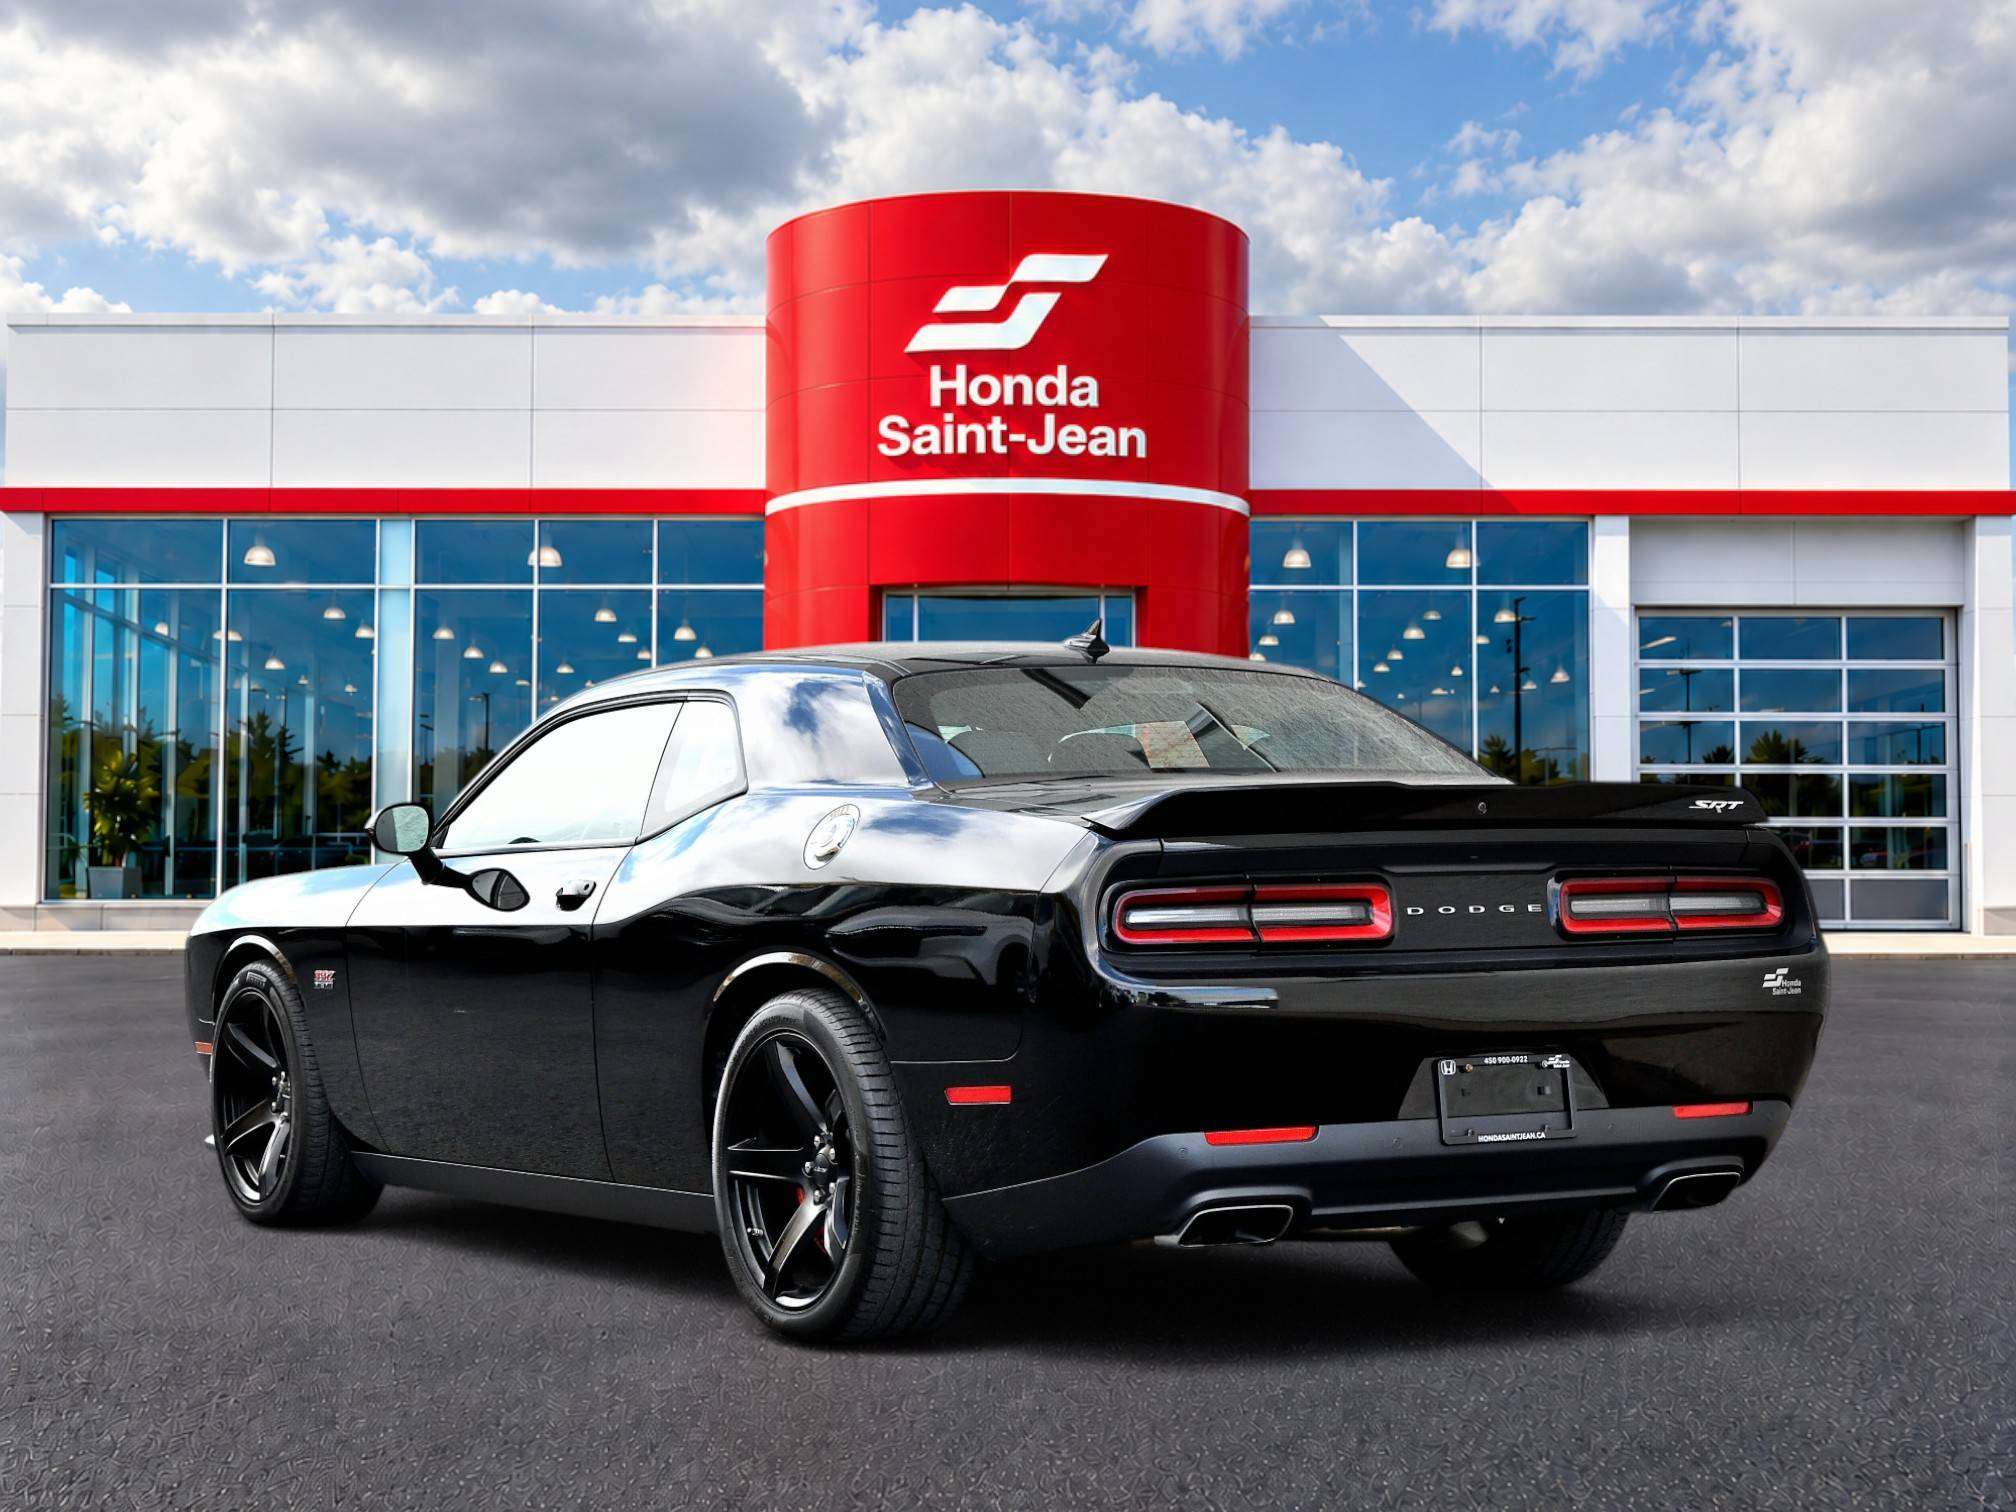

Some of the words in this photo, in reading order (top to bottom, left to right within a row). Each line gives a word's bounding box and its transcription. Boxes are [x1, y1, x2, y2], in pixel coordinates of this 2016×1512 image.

[929, 364, 1099, 408] Honda
[877, 413, 1147, 458] Saint-Jean
[1688, 799, 1744, 813] SRT
[1406, 903, 1542, 915] DODGE
[1478, 1131, 1546, 1143] HONDASAINTJEAN.CA
